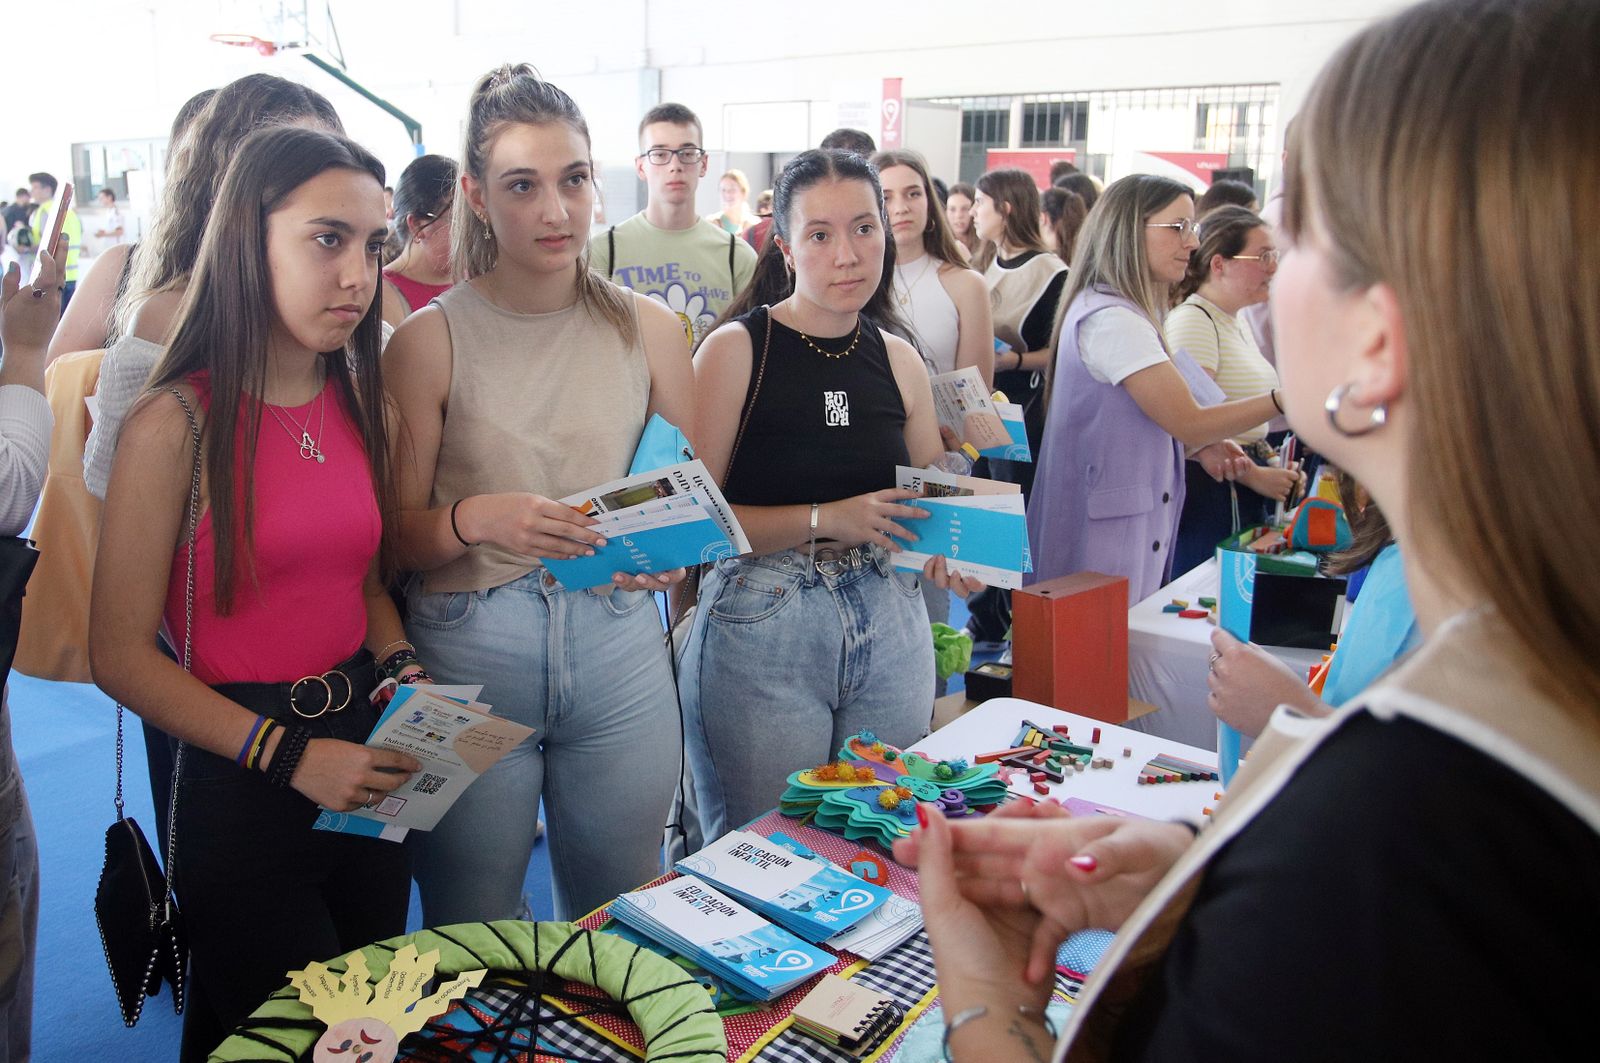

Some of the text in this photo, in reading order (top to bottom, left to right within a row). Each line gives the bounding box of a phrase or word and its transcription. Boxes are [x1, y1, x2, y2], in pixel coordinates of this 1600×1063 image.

[615, 262, 701, 290] TIME TO
[699, 286, 729, 300] HAVE
[673, 470, 691, 492] ara
[728, 848, 771, 870] INFANTIL
[673, 889, 715, 916] INFANTIL
